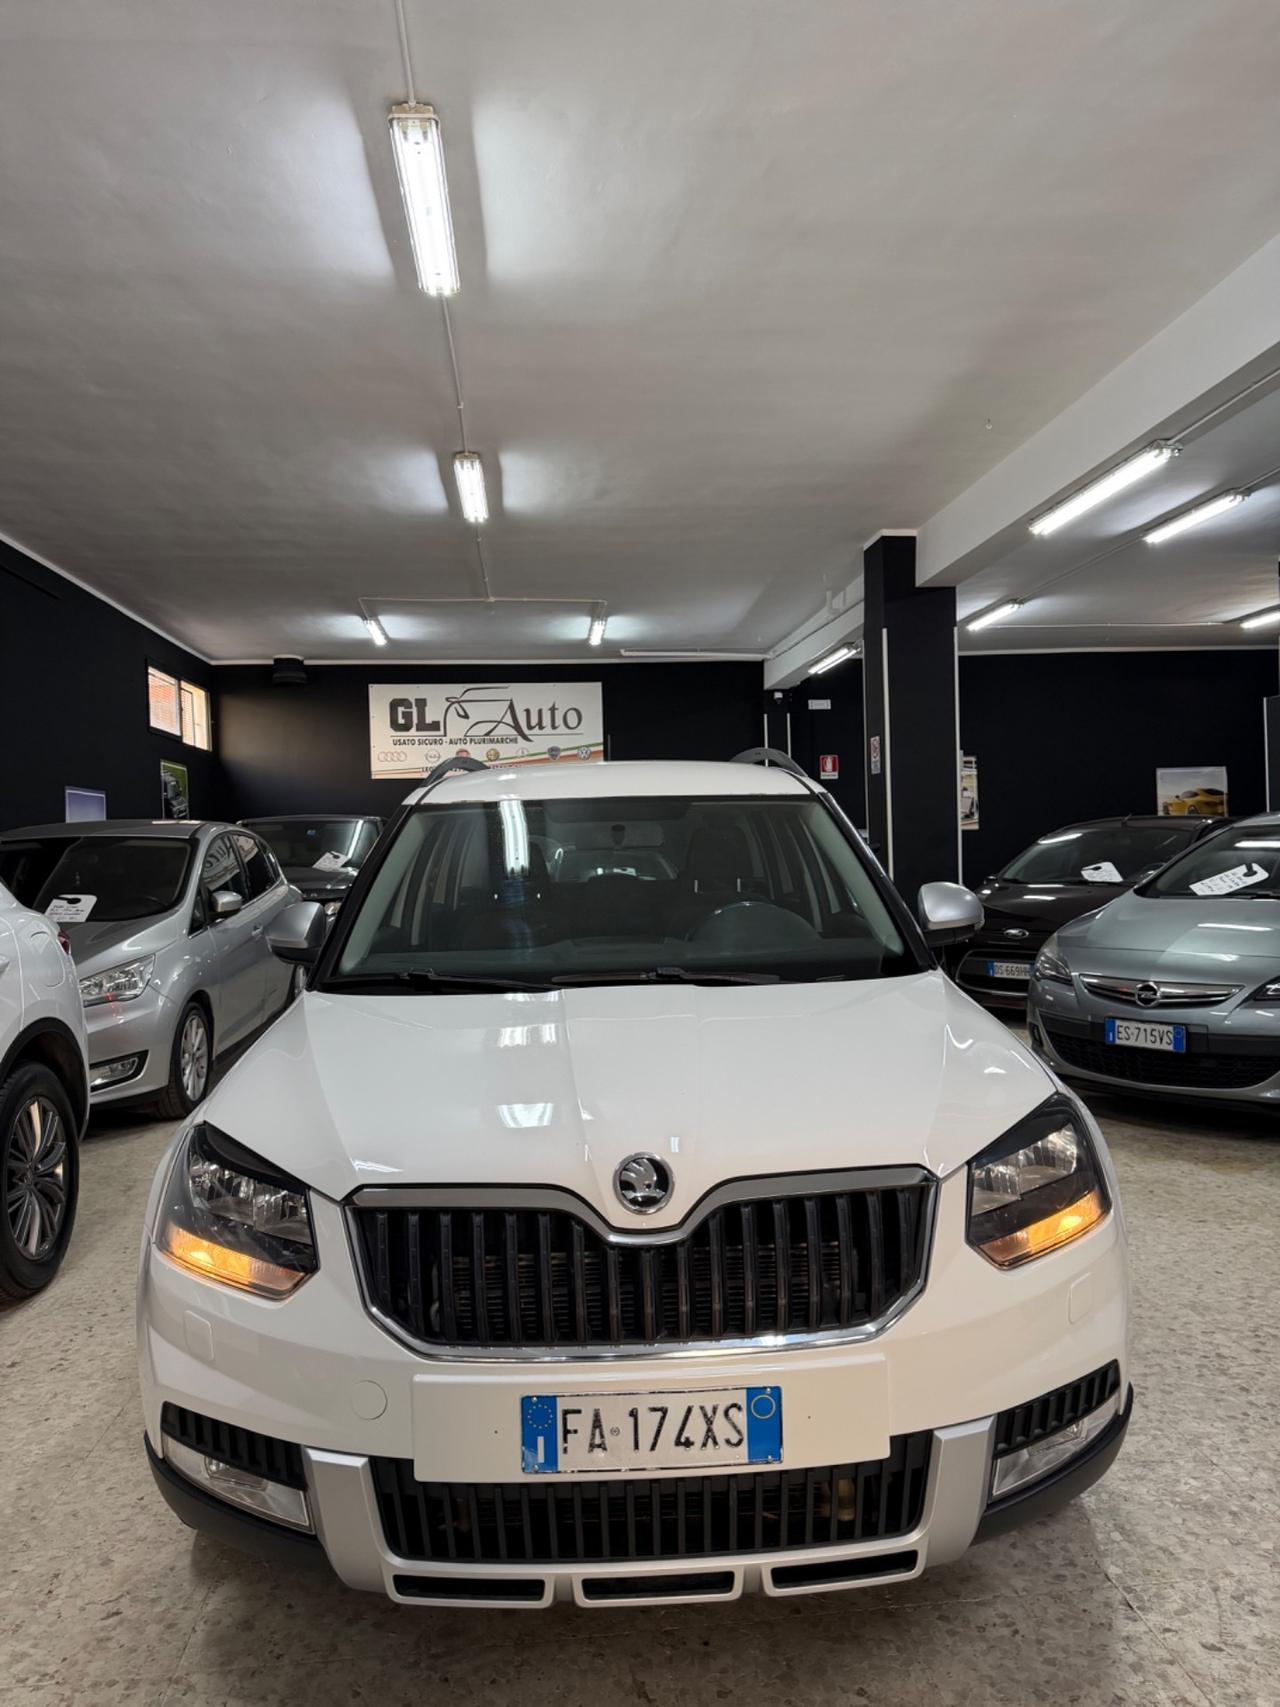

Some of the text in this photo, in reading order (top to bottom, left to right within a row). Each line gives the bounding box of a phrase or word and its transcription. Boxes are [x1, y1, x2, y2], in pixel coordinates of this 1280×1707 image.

[389, 698, 583, 742] GL Auto
[392, 738, 416, 746] USATO
[417, 738, 443, 746] SICURO
[469, 737, 519, 745] PLURIMARCHE
